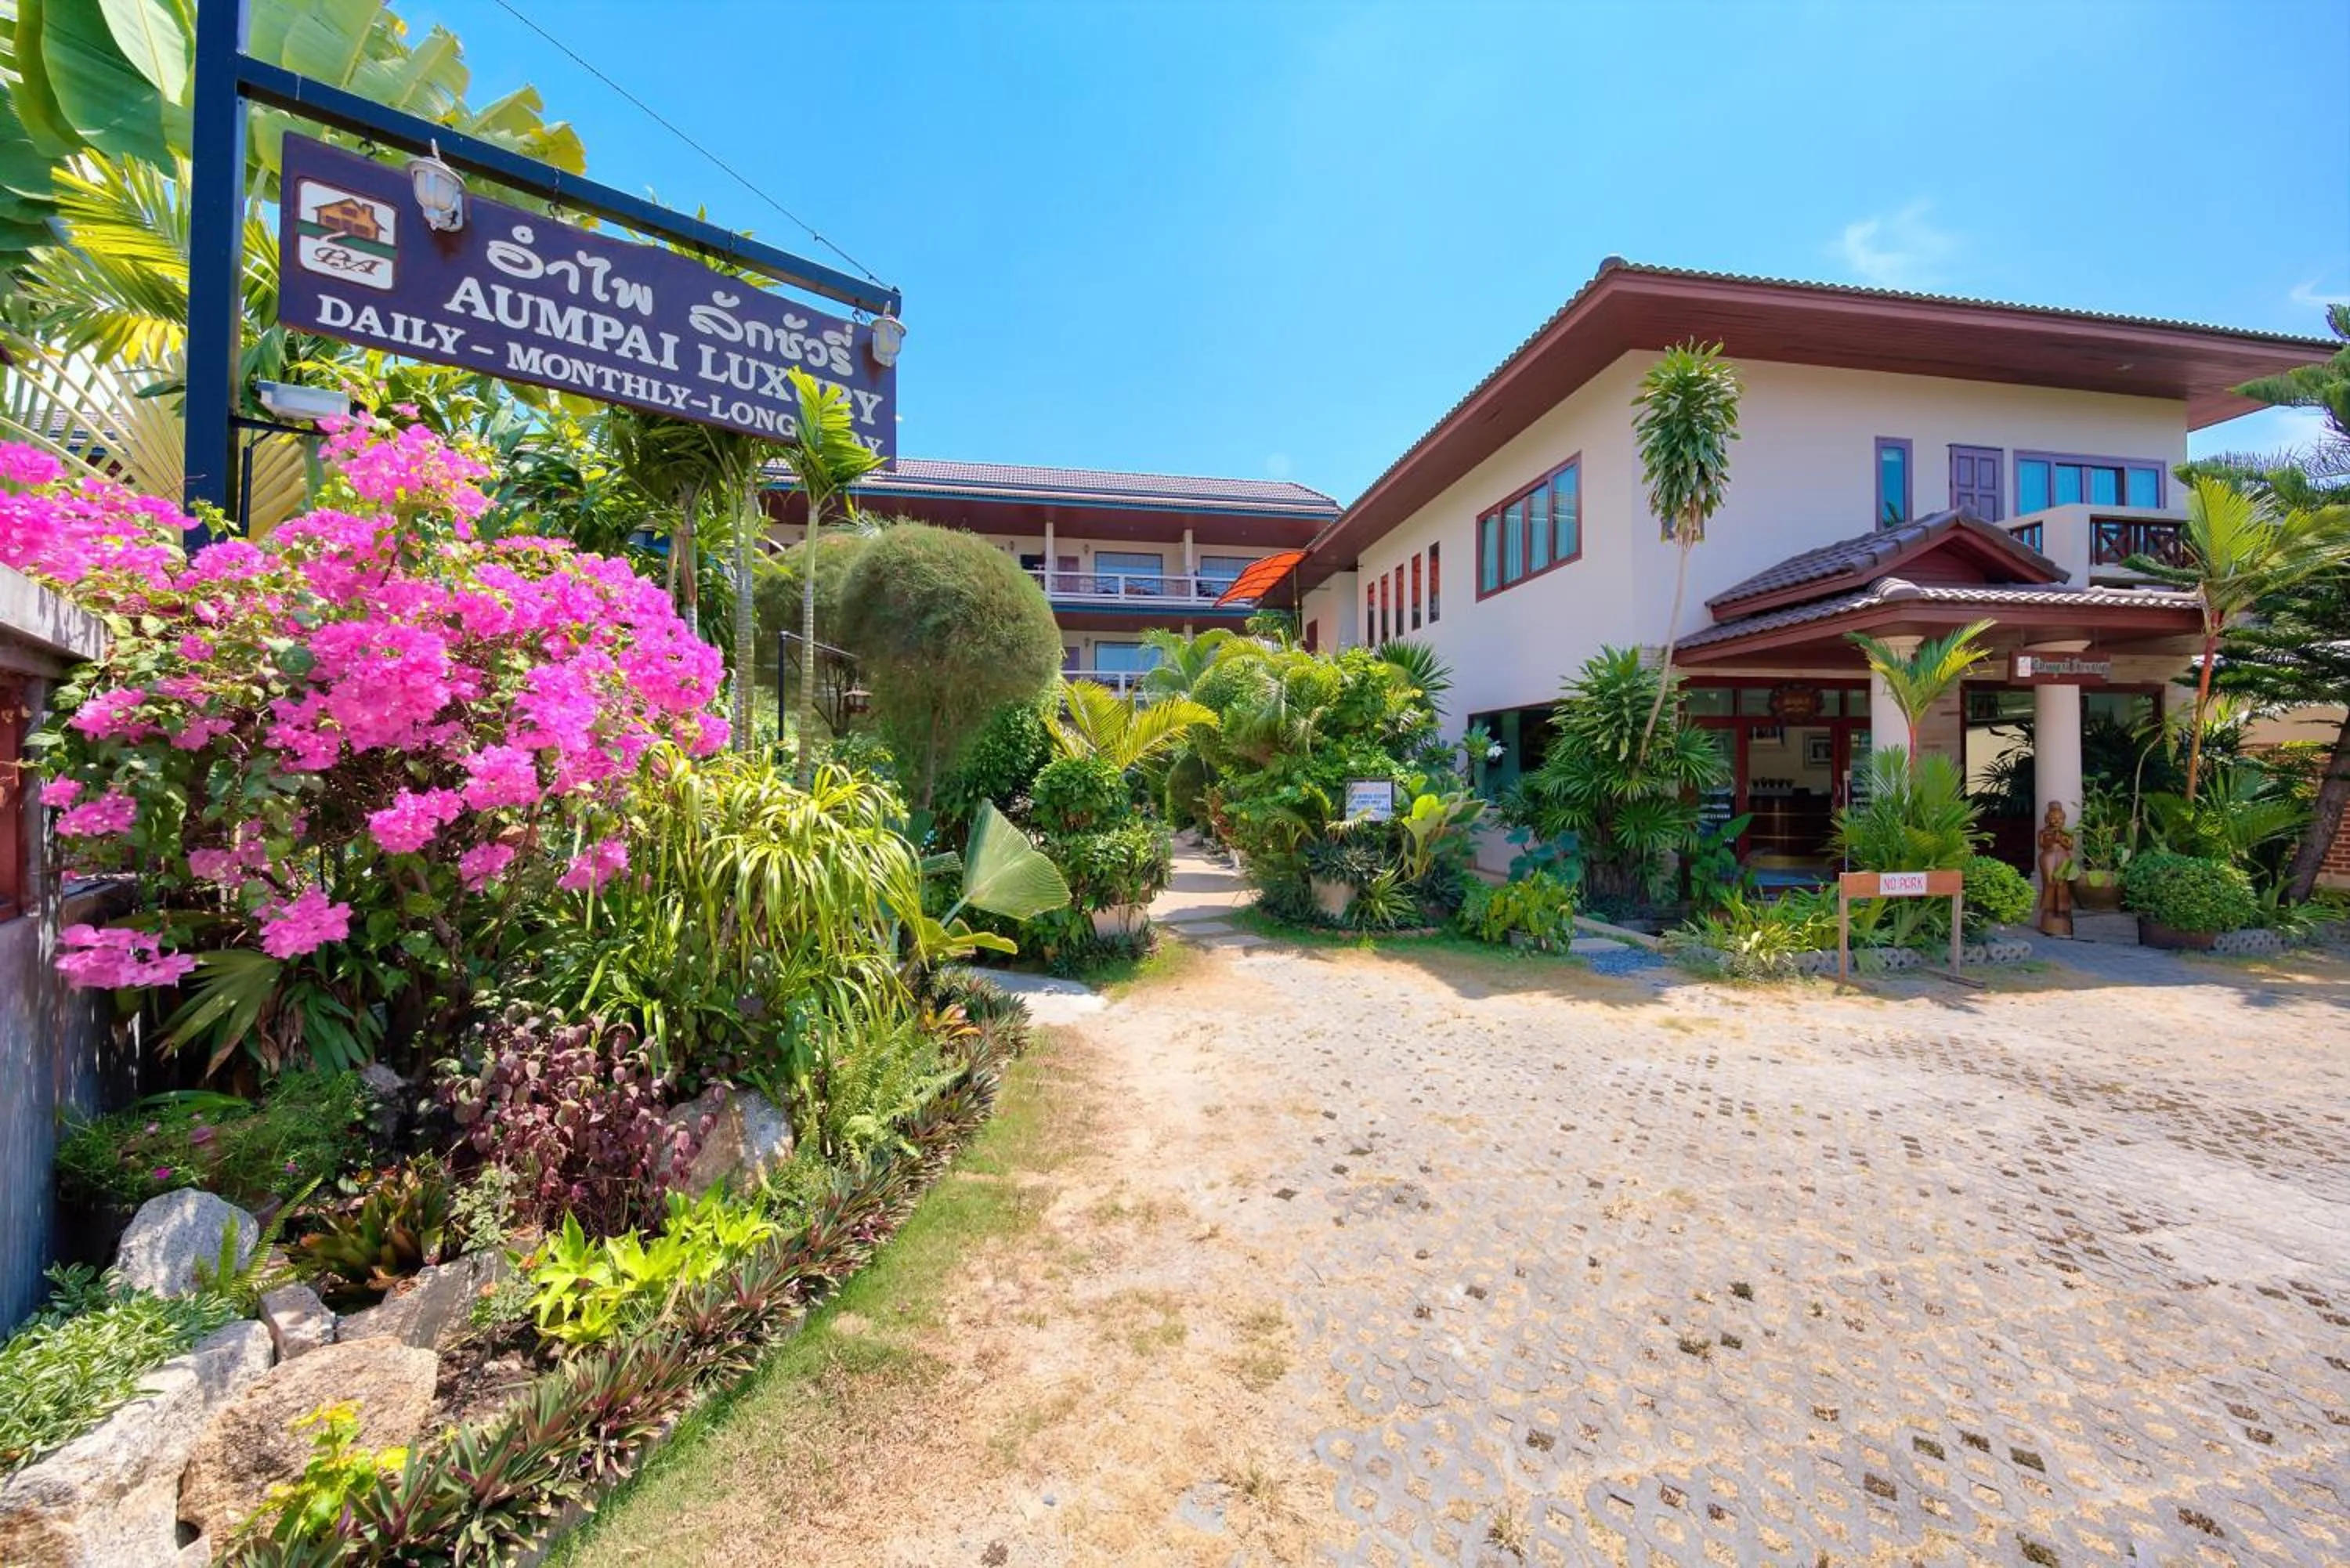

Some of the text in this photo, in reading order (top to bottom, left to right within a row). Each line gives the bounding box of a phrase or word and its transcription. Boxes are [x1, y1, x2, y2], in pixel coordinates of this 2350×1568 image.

[486, 225, 653, 316] อำไพ
[316, 294, 466, 355] DAILY
[443, 276, 680, 370] AUMPAI
